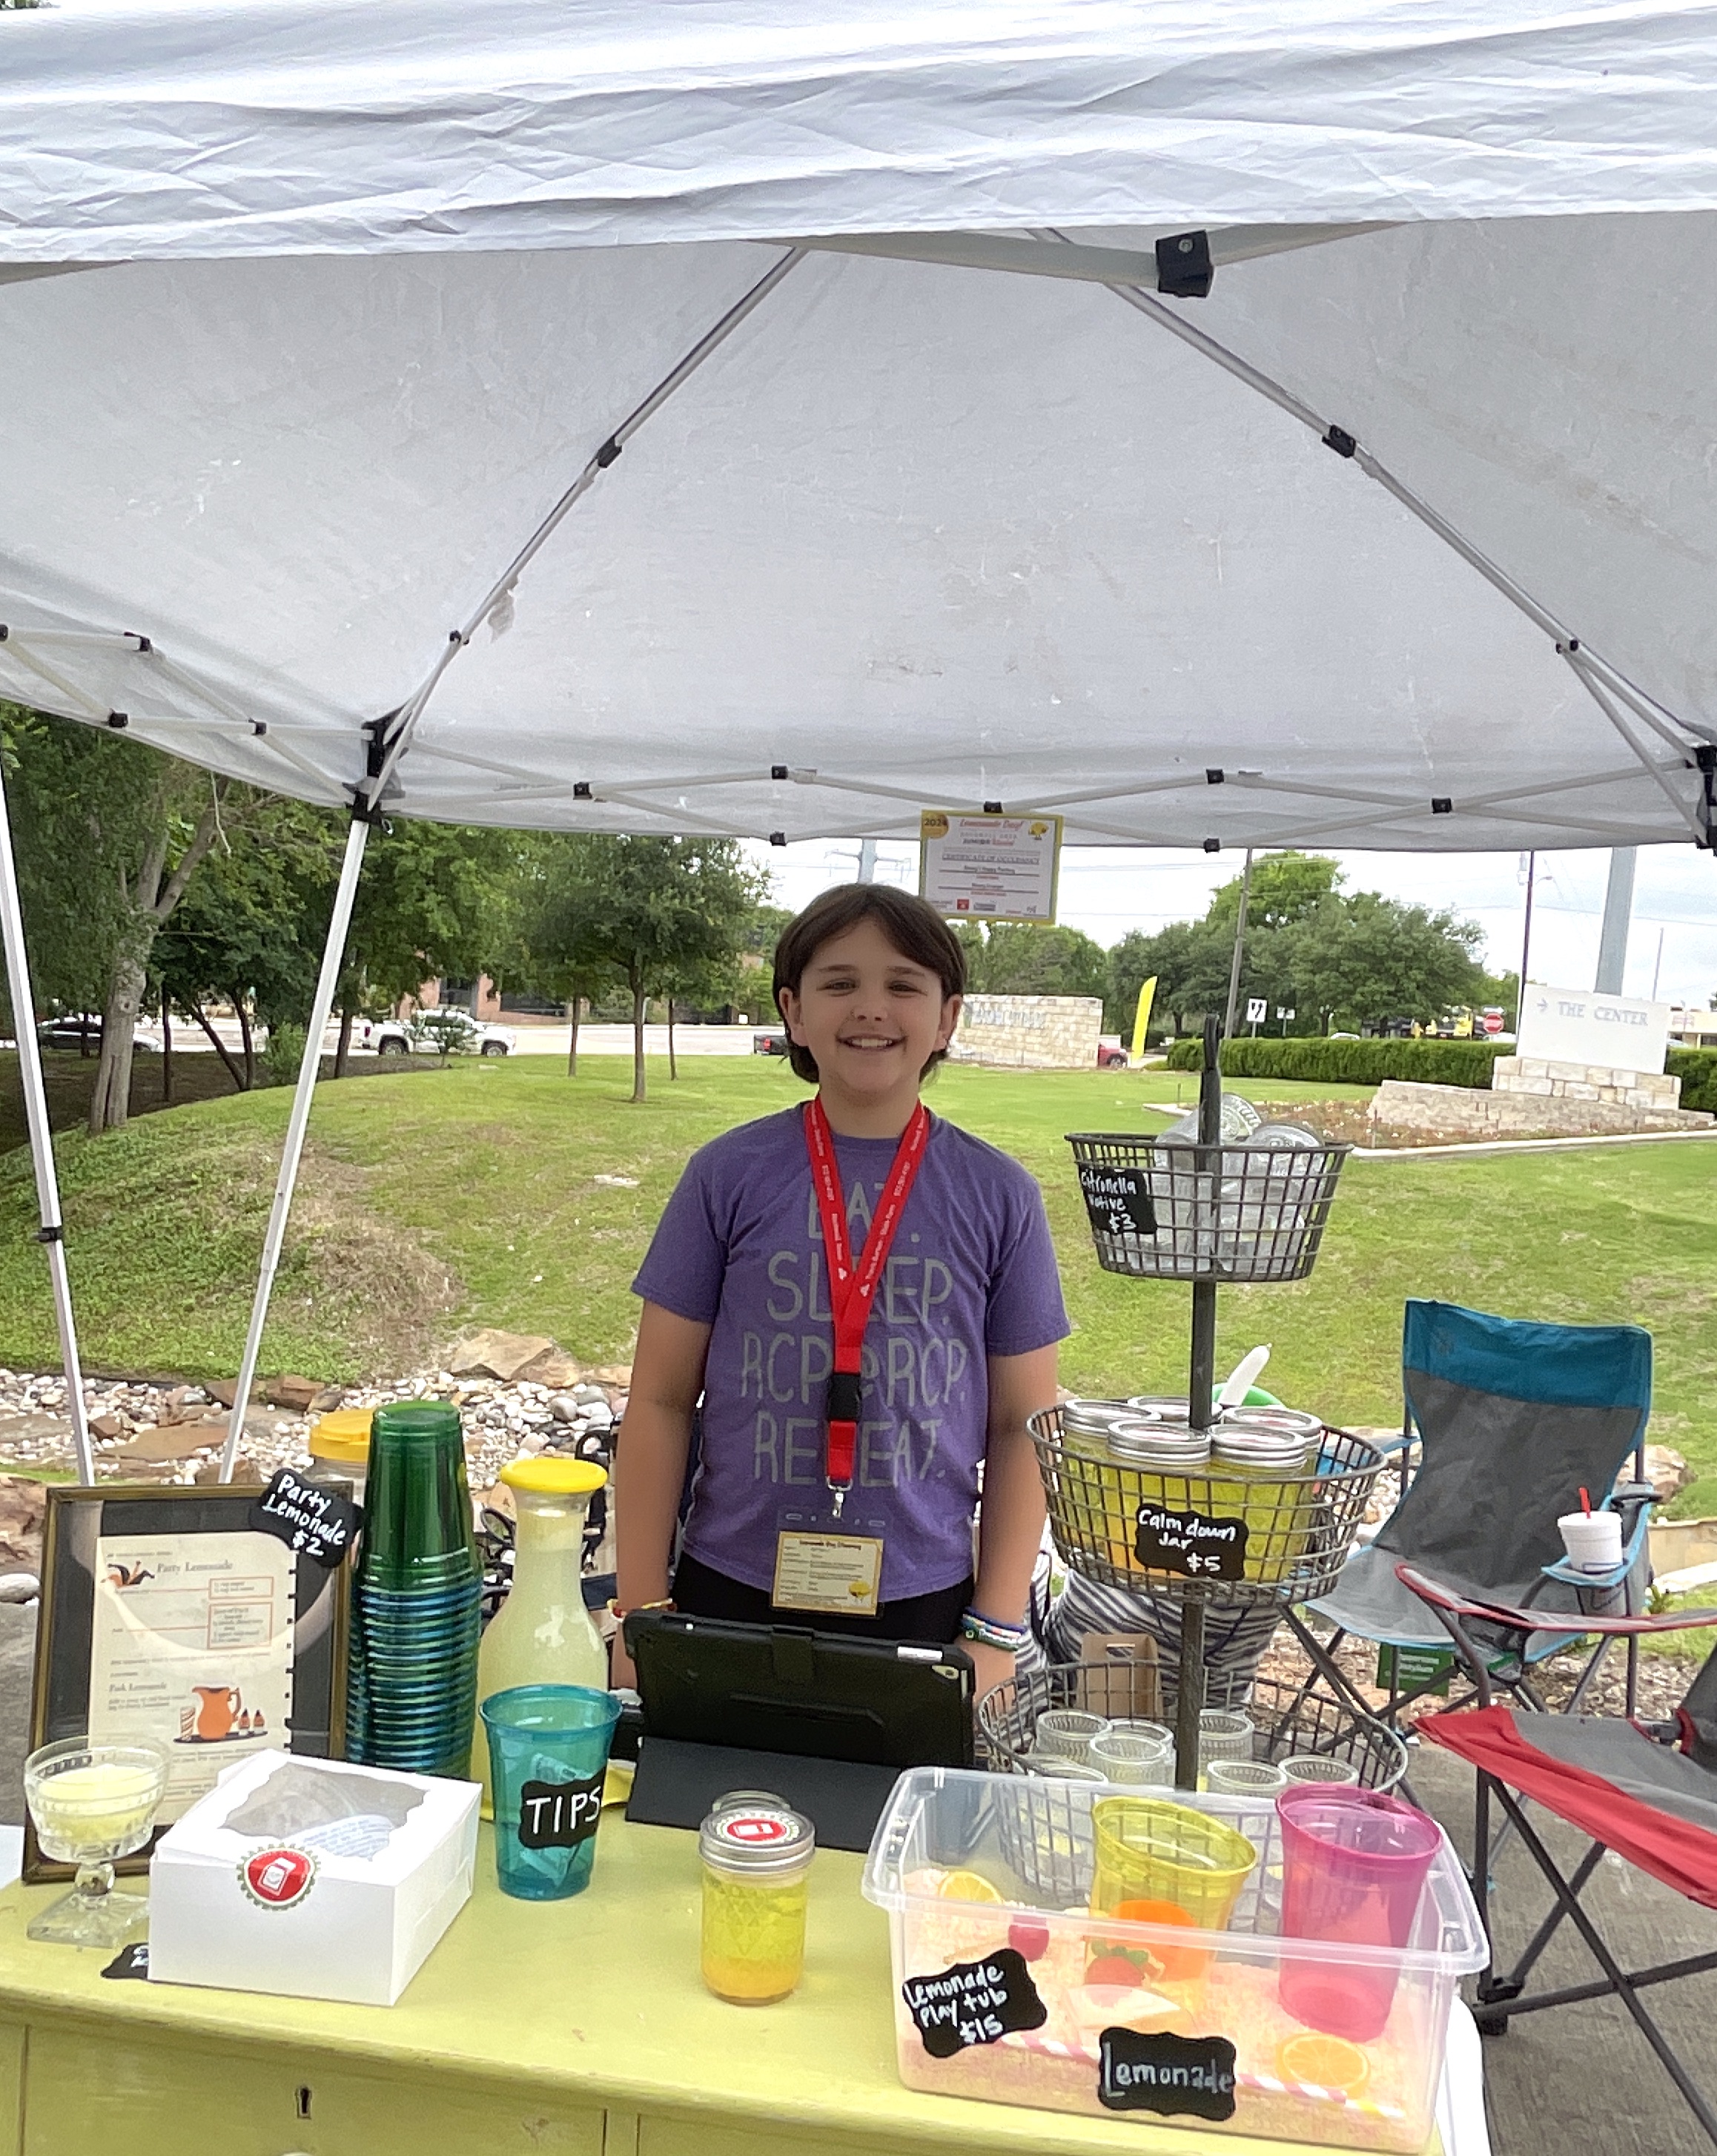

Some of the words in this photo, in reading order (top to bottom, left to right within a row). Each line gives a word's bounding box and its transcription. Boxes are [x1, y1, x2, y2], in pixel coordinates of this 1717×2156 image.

[1557, 1001, 1586, 1019] THE
[1594, 1006, 1648, 1026] CENTER
[767, 1250, 953, 1326] SLEP.
[754, 1410, 946, 1488] REEAT.
[277, 1474, 332, 1518] Party
[261, 1493, 347, 1546] Lemonade
[1139, 1509, 1182, 1532] Calm
[1185, 1518, 1237, 1542] down
[292, 1529, 325, 1556] $2
[1186, 1552, 1221, 1573] $5
[525, 1785, 602, 1835] TIPS
[904, 1964, 1005, 2009] Lemonade
[963, 1988, 1008, 2012] tub
[959, 2014, 1003, 2044] $15
[1102, 2041, 1235, 2097] Lemonade
